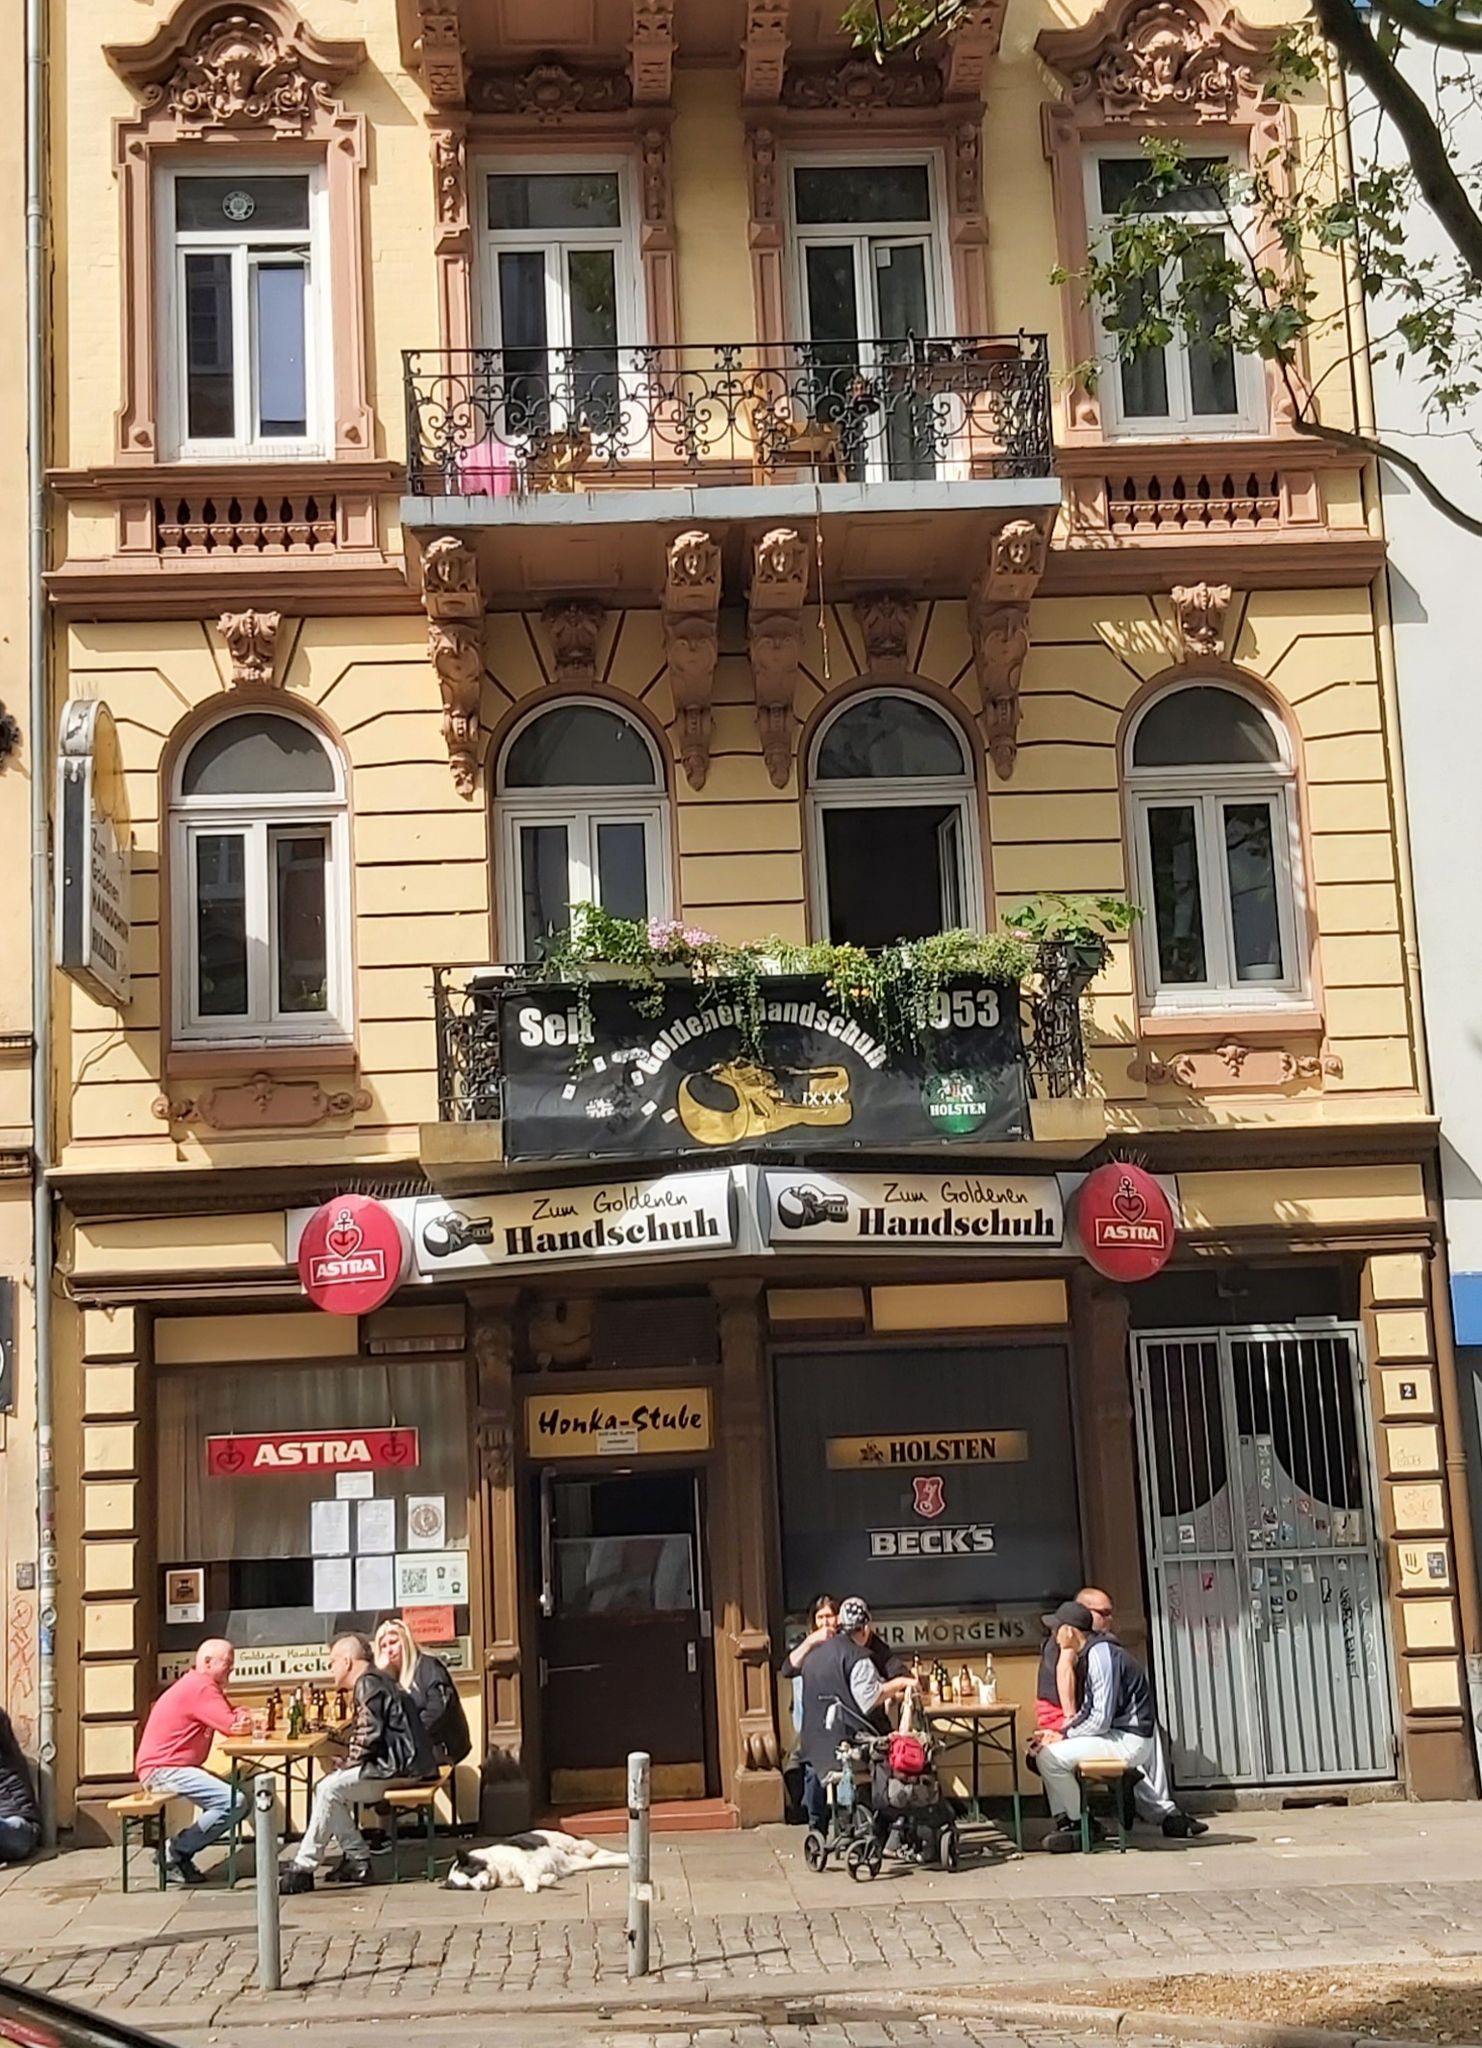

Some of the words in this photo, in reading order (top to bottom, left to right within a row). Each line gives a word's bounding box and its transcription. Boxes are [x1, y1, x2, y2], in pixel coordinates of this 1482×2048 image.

[518, 1006, 595, 1047] Seit
[929, 1102, 986, 1117] HOLSTEN
[532, 1197, 578, 1221] Zum
[593, 1186, 688, 1214] Goldenen
[881, 1182, 928, 1204] Zum
[940, 1181, 1029, 1204] Goldenen
[504, 1208, 721, 1257] Handschuh
[856, 1207, 1055, 1238] Handschuh
[1102, 1225, 1161, 1243] ASTRA
[315, 1258, 378, 1279] ASTRA
[1403, 1384, 1413, 1398] 2
[538, 1404, 702, 1436] Honka-Stube
[253, 1439, 371, 1467] ASTRA
[890, 1437, 996, 1463] HOLSTEN
[870, 1525, 994, 1556] BECK'S
[874, 1625, 904, 1643] HR
[914, 1621, 1025, 1642] MORGENS
